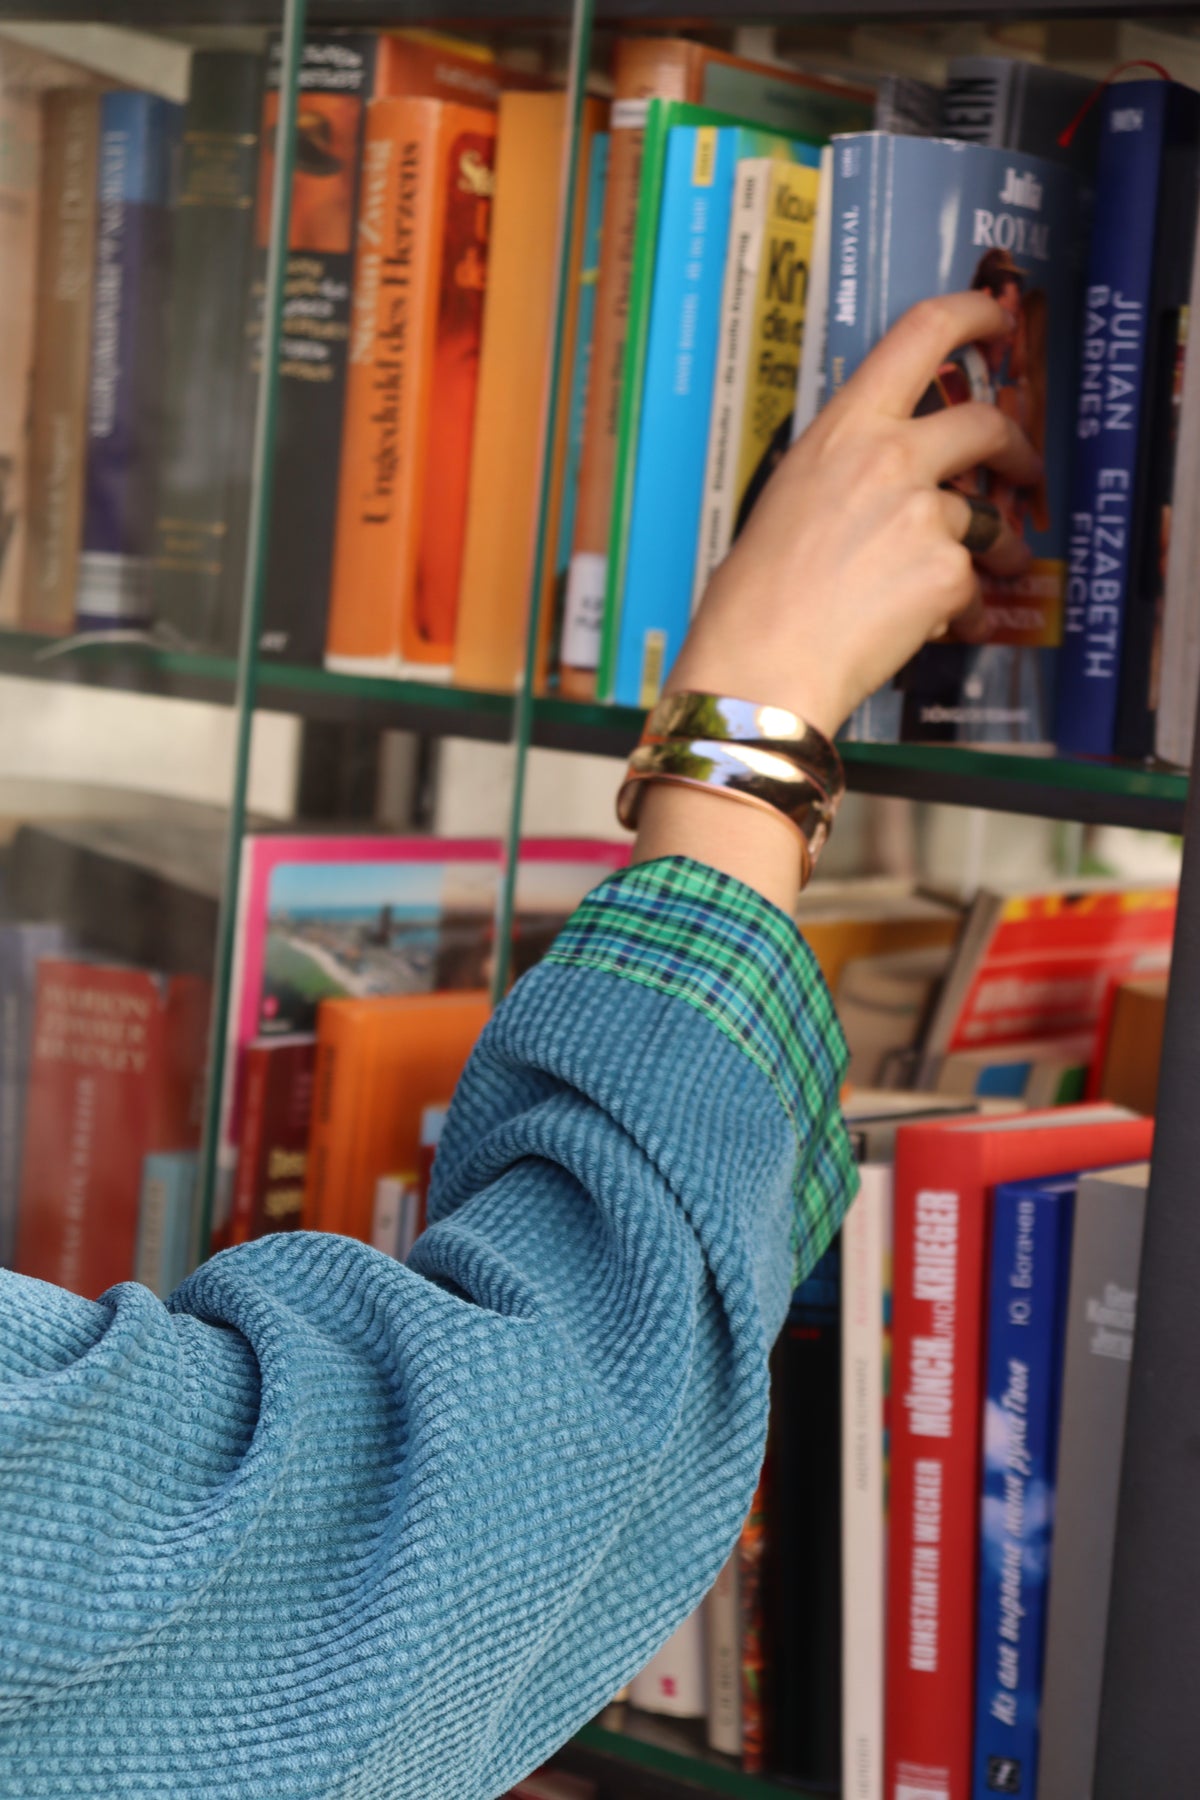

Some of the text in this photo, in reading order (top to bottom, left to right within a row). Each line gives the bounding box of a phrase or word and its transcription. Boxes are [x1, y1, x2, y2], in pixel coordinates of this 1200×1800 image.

[972, 209, 1052, 261] ROYAL
[999, 167, 1043, 210] Julia
[834, 205, 860, 326] Julia ROYAL
[360, 141, 420, 525] Ungeduld des Herzens
[1077, 285, 1111, 439] BARNES
[1105, 291, 1142, 430] JULIAN
[1066, 512, 1094, 633] FINCH
[1084, 468, 1130, 678] ELIZABETH
[913, 1191, 959, 1302] KRIEGER
[1011, 1202, 1036, 1326] Ю. Богачев
[904, 1338, 954, 1437] MÖNCH
[909, 1459, 942, 1671] KONSTANTIN WECKER
[990, 1694, 1018, 1726] Из
